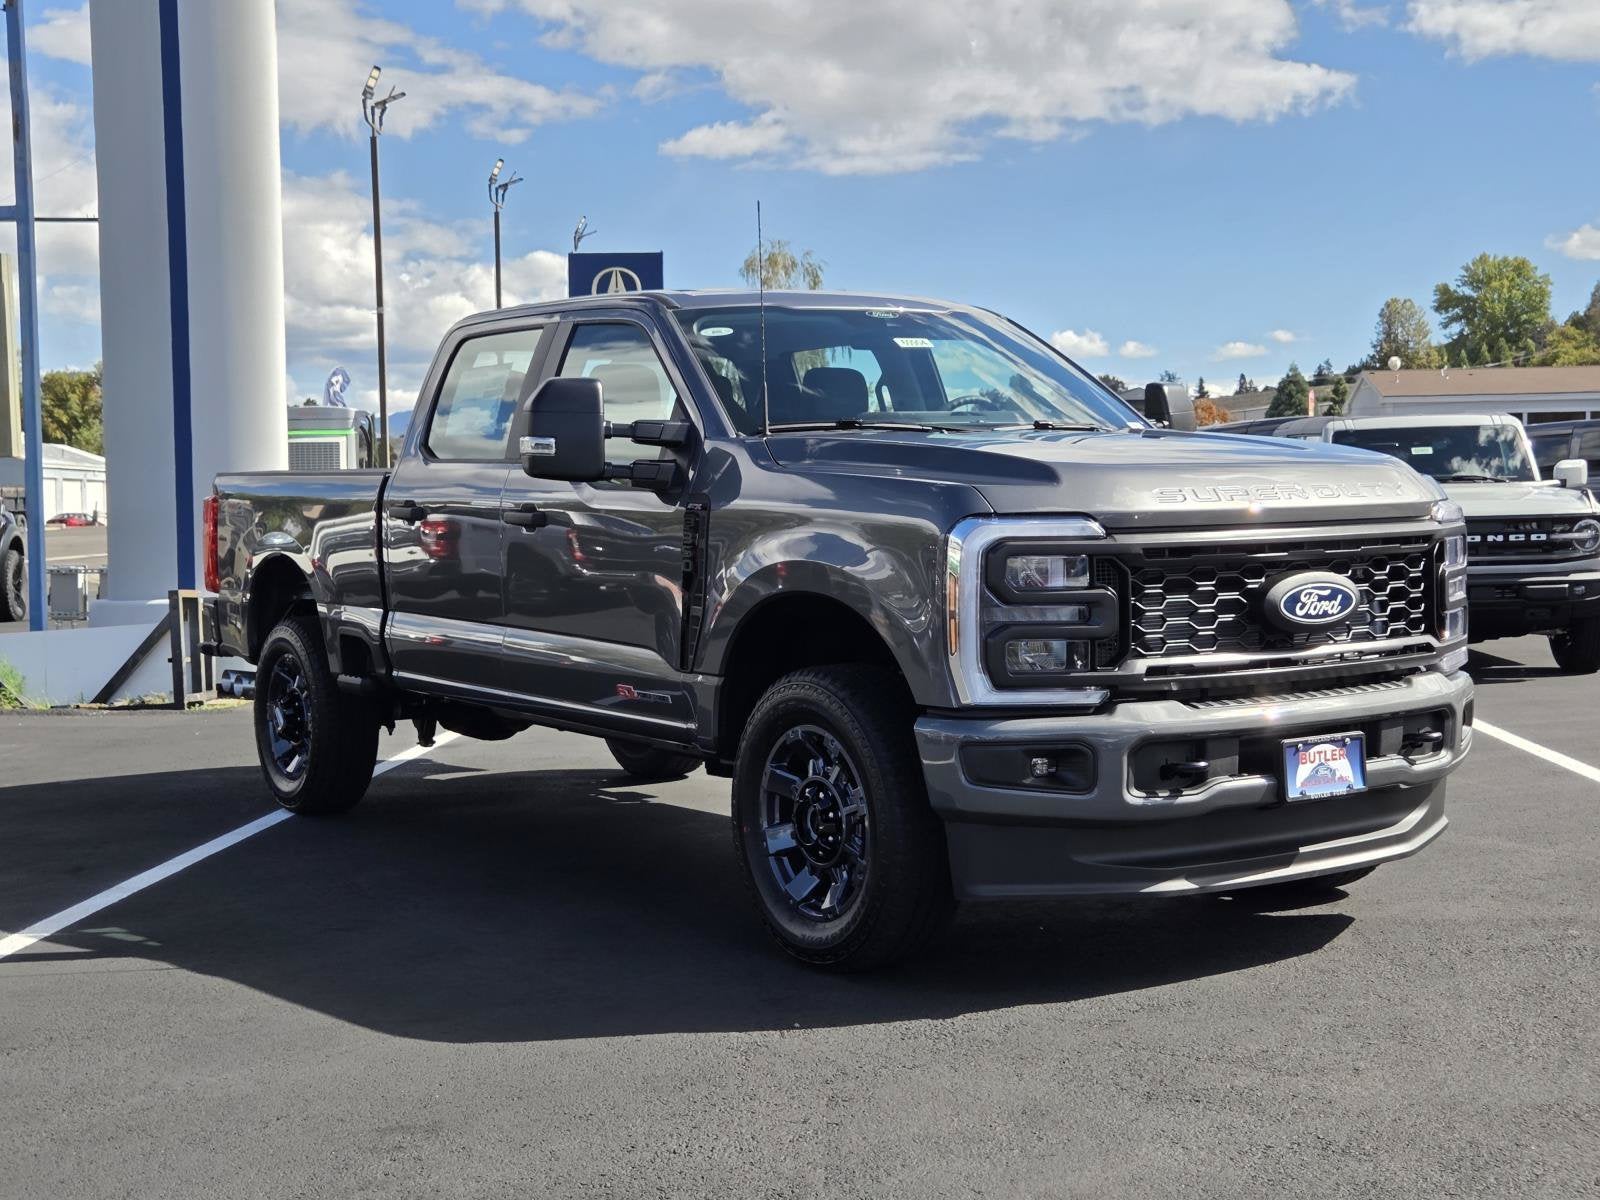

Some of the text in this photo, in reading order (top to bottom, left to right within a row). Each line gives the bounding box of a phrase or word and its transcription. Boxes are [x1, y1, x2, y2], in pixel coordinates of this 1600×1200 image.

[1156, 481, 1407, 503] SUPER DUTY
[1295, 588, 1342, 616] Ford
[1300, 748, 1346, 765] BUTLER
